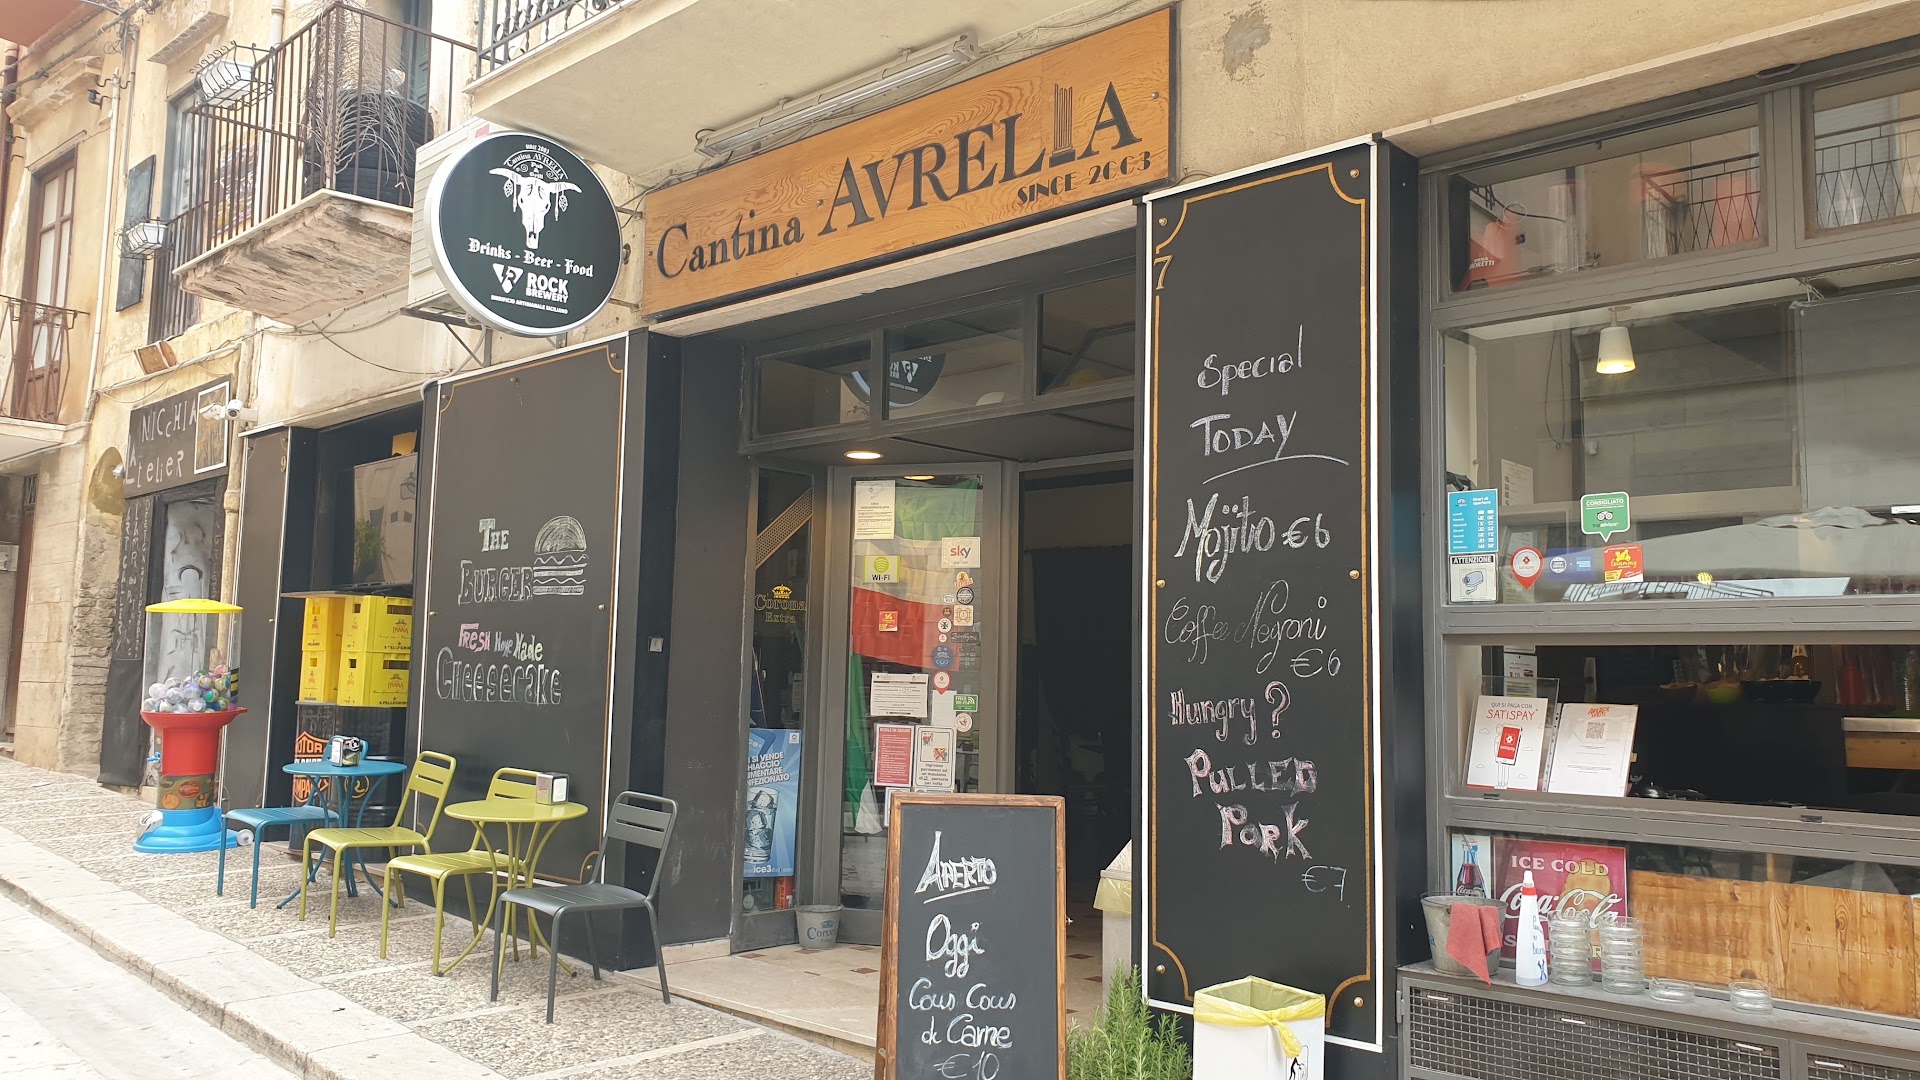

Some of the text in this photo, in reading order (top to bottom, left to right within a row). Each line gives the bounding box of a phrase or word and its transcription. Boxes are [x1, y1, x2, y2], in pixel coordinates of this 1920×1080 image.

[507, 153, 564, 179] Cantina AVRELIA
[1017, 170, 1074, 206] SINCE
[656, 210, 804, 280] Cantina
[468, 238, 511, 260] Drinks
[523, 250, 554, 268] Beer
[564, 259, 593, 278] Food
[527, 272, 569, 296] ROCK
[1154, 254, 1171, 291] 7
[525, 287, 569, 304] BREWERY
[1197, 325, 1303, 396] Special
[280, 456, 287, 473] 9
[1586, 498, 1624, 507] CONSIGLIATO
[950, 545, 972, 559] sky
[1453, 556, 1491, 565] ATTENZIONE
[458, 560, 533, 607] BURGER
[753, 594, 807, 611] Corona
[764, 611, 796, 624] Extra
[1486, 709, 1535, 721] SATISPAY
[760, 752, 784, 761] VENDE
[914, 831, 997, 894] APERTO
[1511, 855, 1609, 876] ICE COLD
[926, 913, 985, 979] Oggi
[909, 976, 1018, 1011] Cous Cous
[946, 1013, 1013, 1049] Carne
